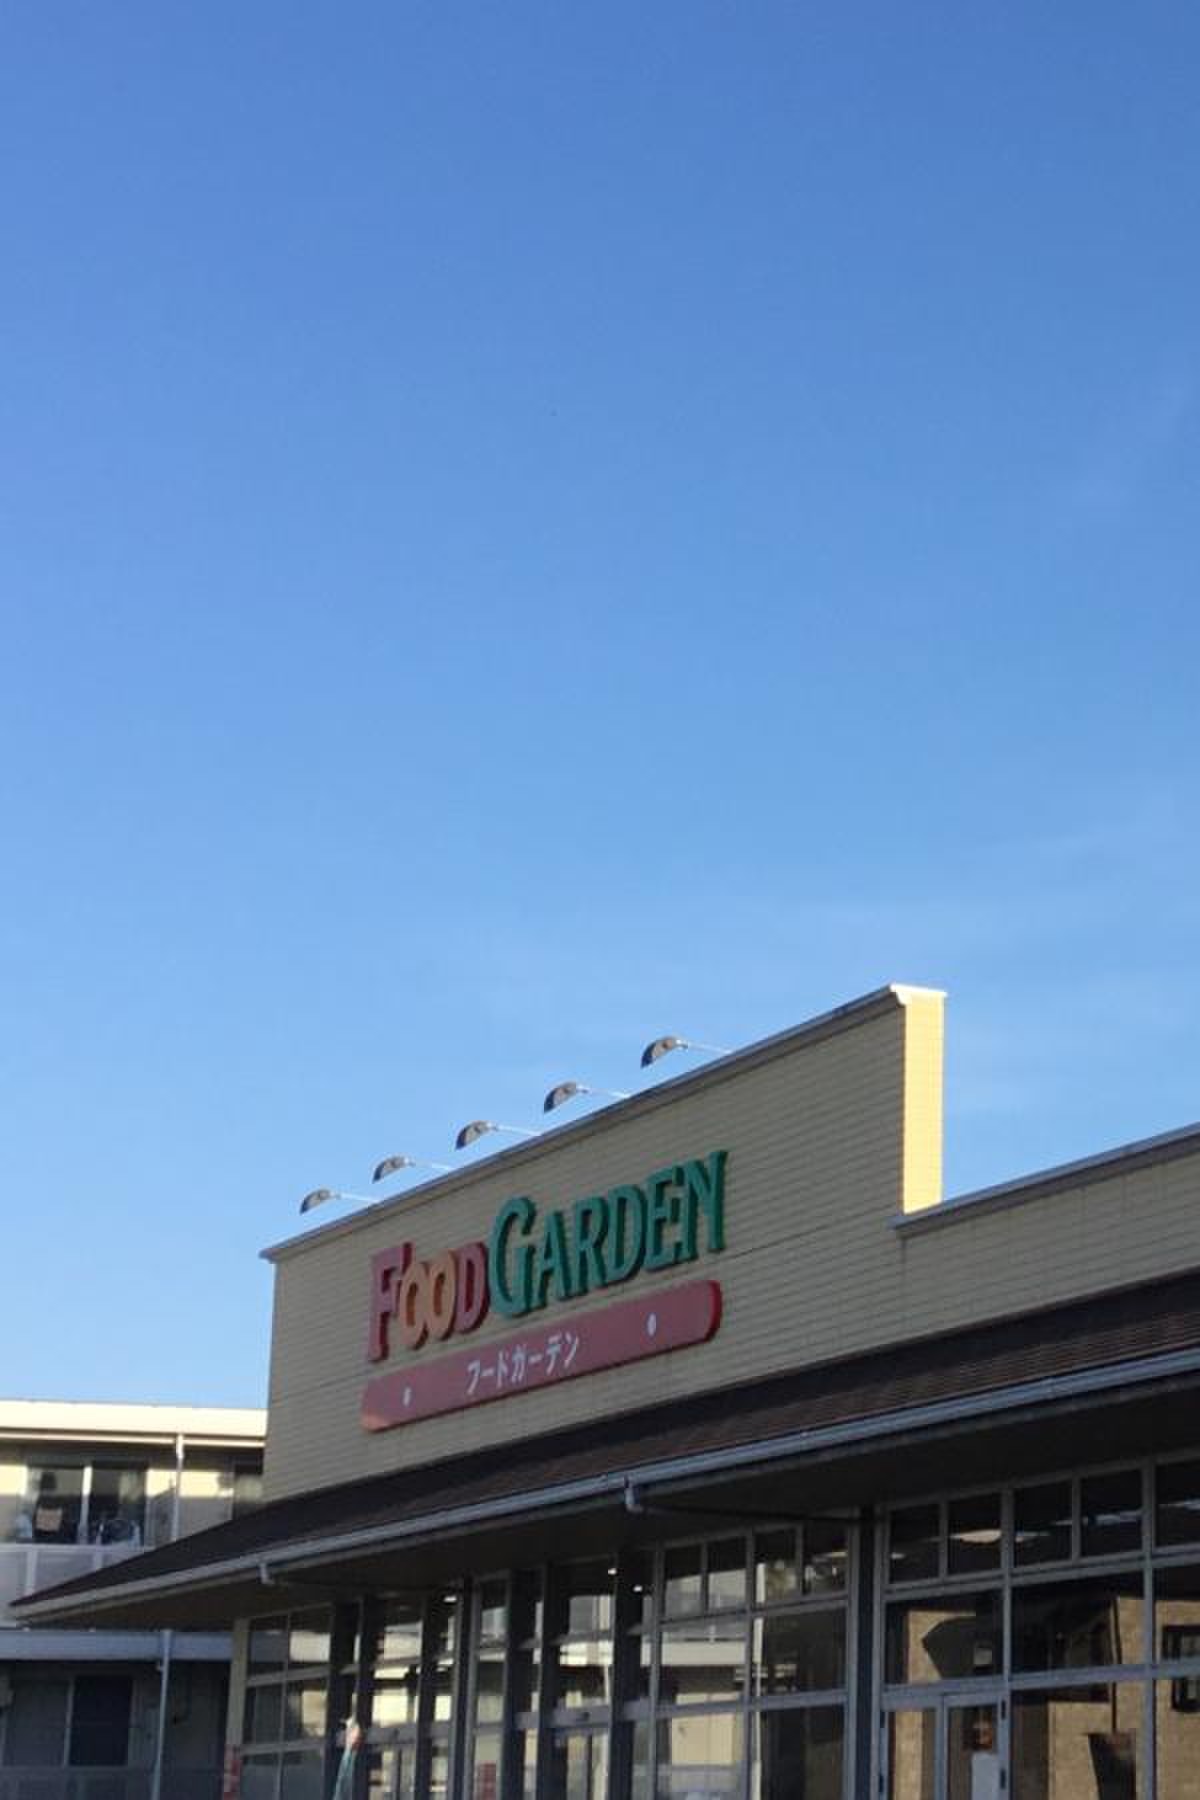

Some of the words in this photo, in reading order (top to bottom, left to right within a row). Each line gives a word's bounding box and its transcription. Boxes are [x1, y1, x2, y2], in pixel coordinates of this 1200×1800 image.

[366, 1242, 489, 1361] FOOD
[489, 1150, 728, 1318] GARDEN
[467, 1331, 579, 1395] フードガーデン
